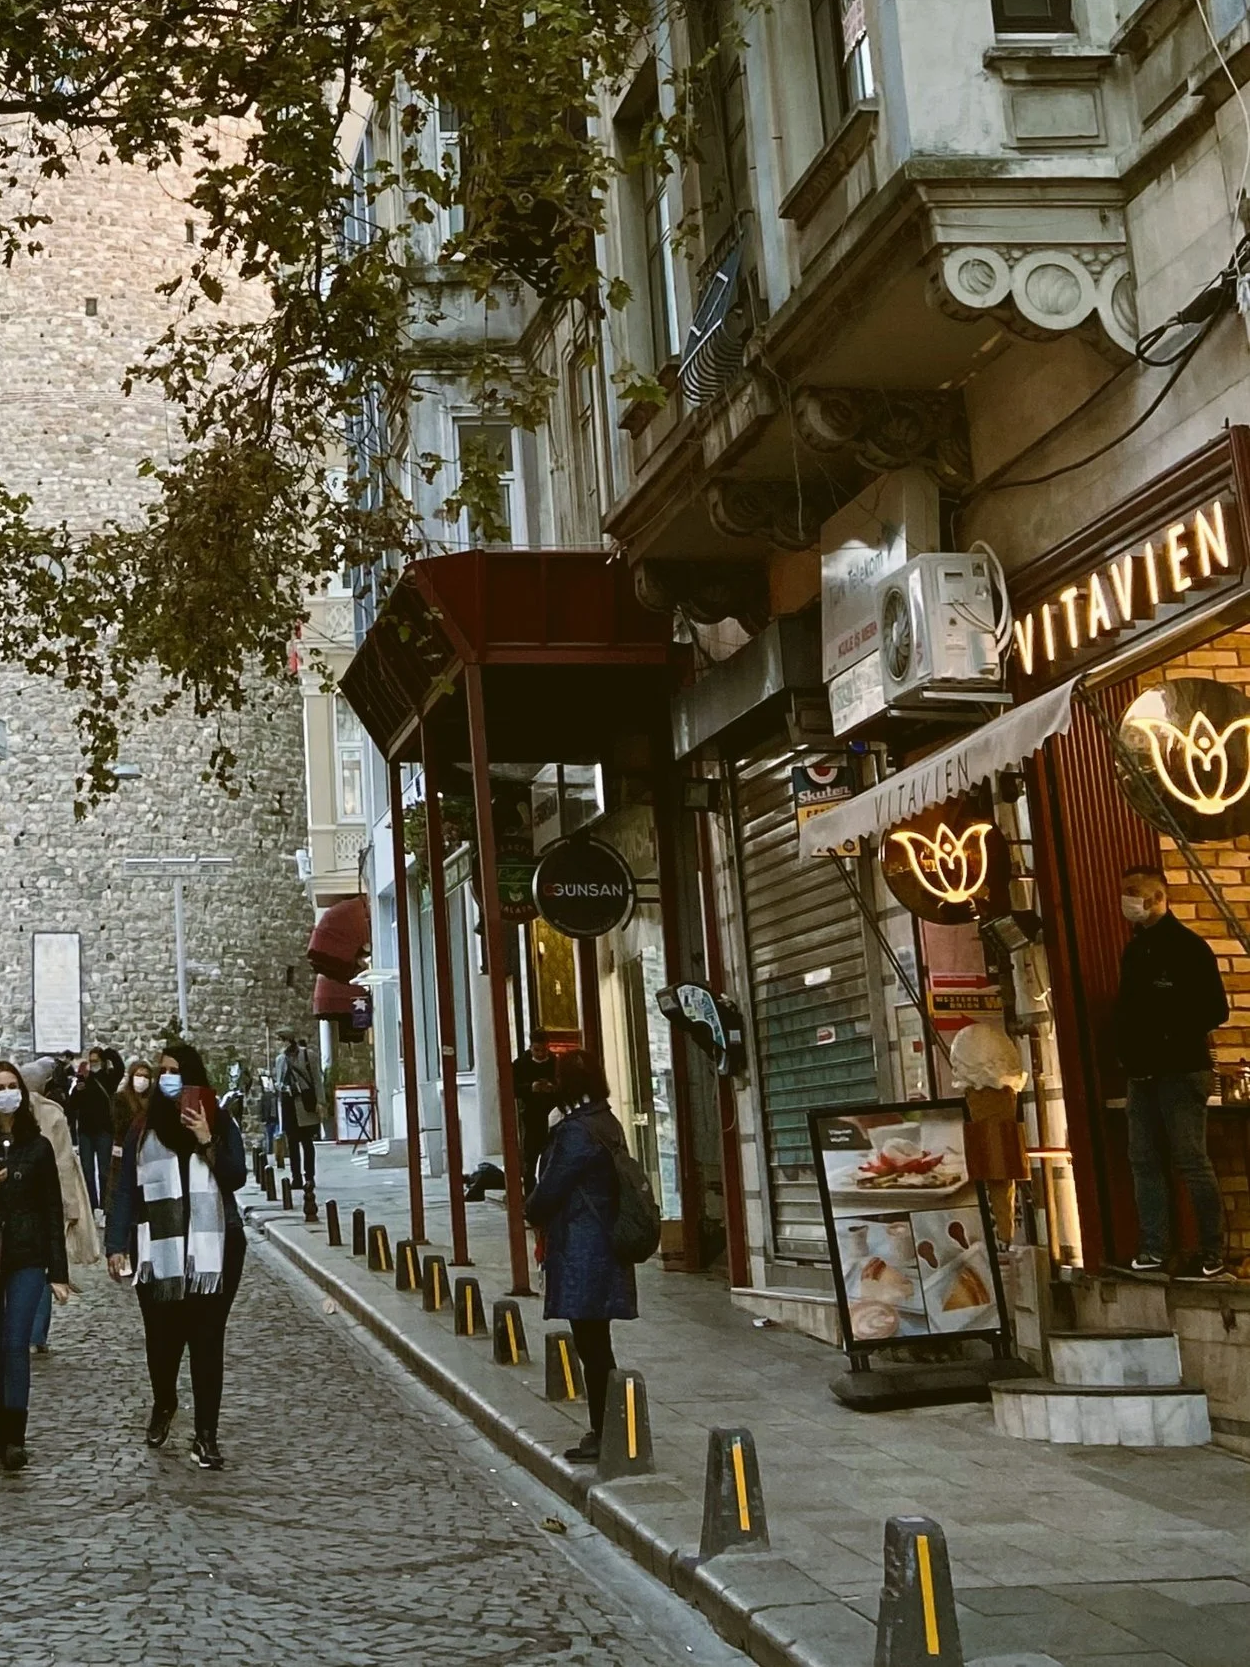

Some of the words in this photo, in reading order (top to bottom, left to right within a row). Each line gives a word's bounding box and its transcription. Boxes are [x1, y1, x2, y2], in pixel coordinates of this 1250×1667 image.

[847, 550, 885, 591] Telekom
[1014, 500, 1230, 675] VITAVIEN
[874, 750, 971, 826] VITAVIEN
